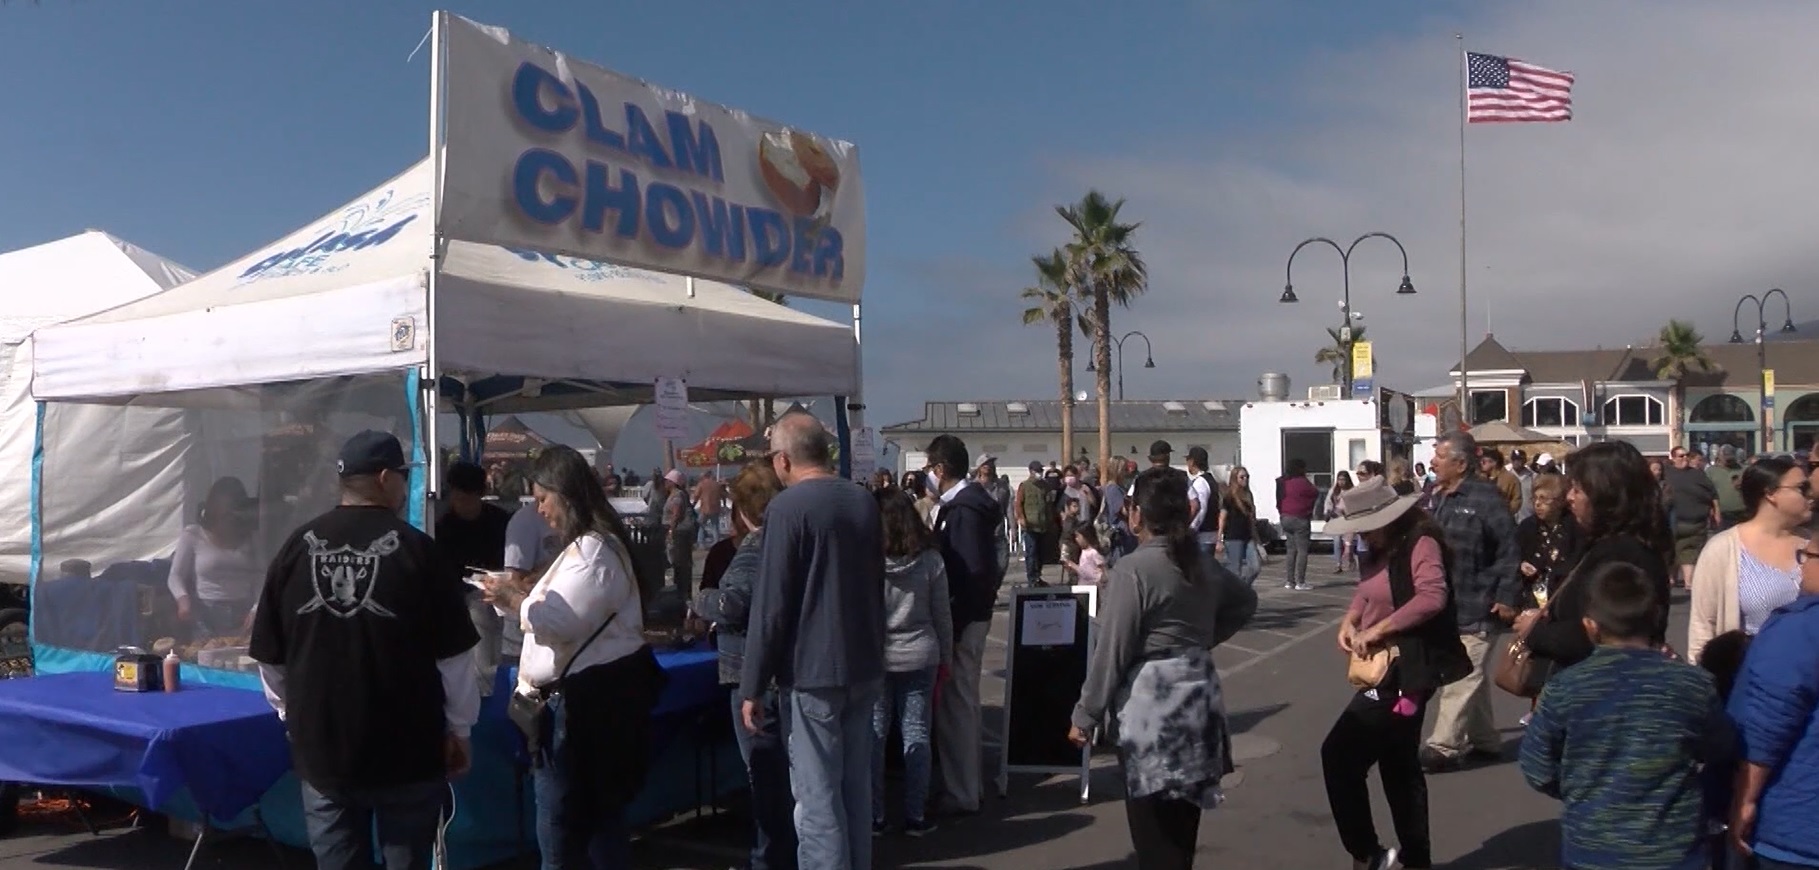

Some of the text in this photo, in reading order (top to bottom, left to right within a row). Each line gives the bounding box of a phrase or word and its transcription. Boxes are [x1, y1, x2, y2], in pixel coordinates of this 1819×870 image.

[512, 61, 725, 183] CLAM
[513, 147, 844, 281] CHOWDER
[320, 554, 371, 565] RAIDERS
